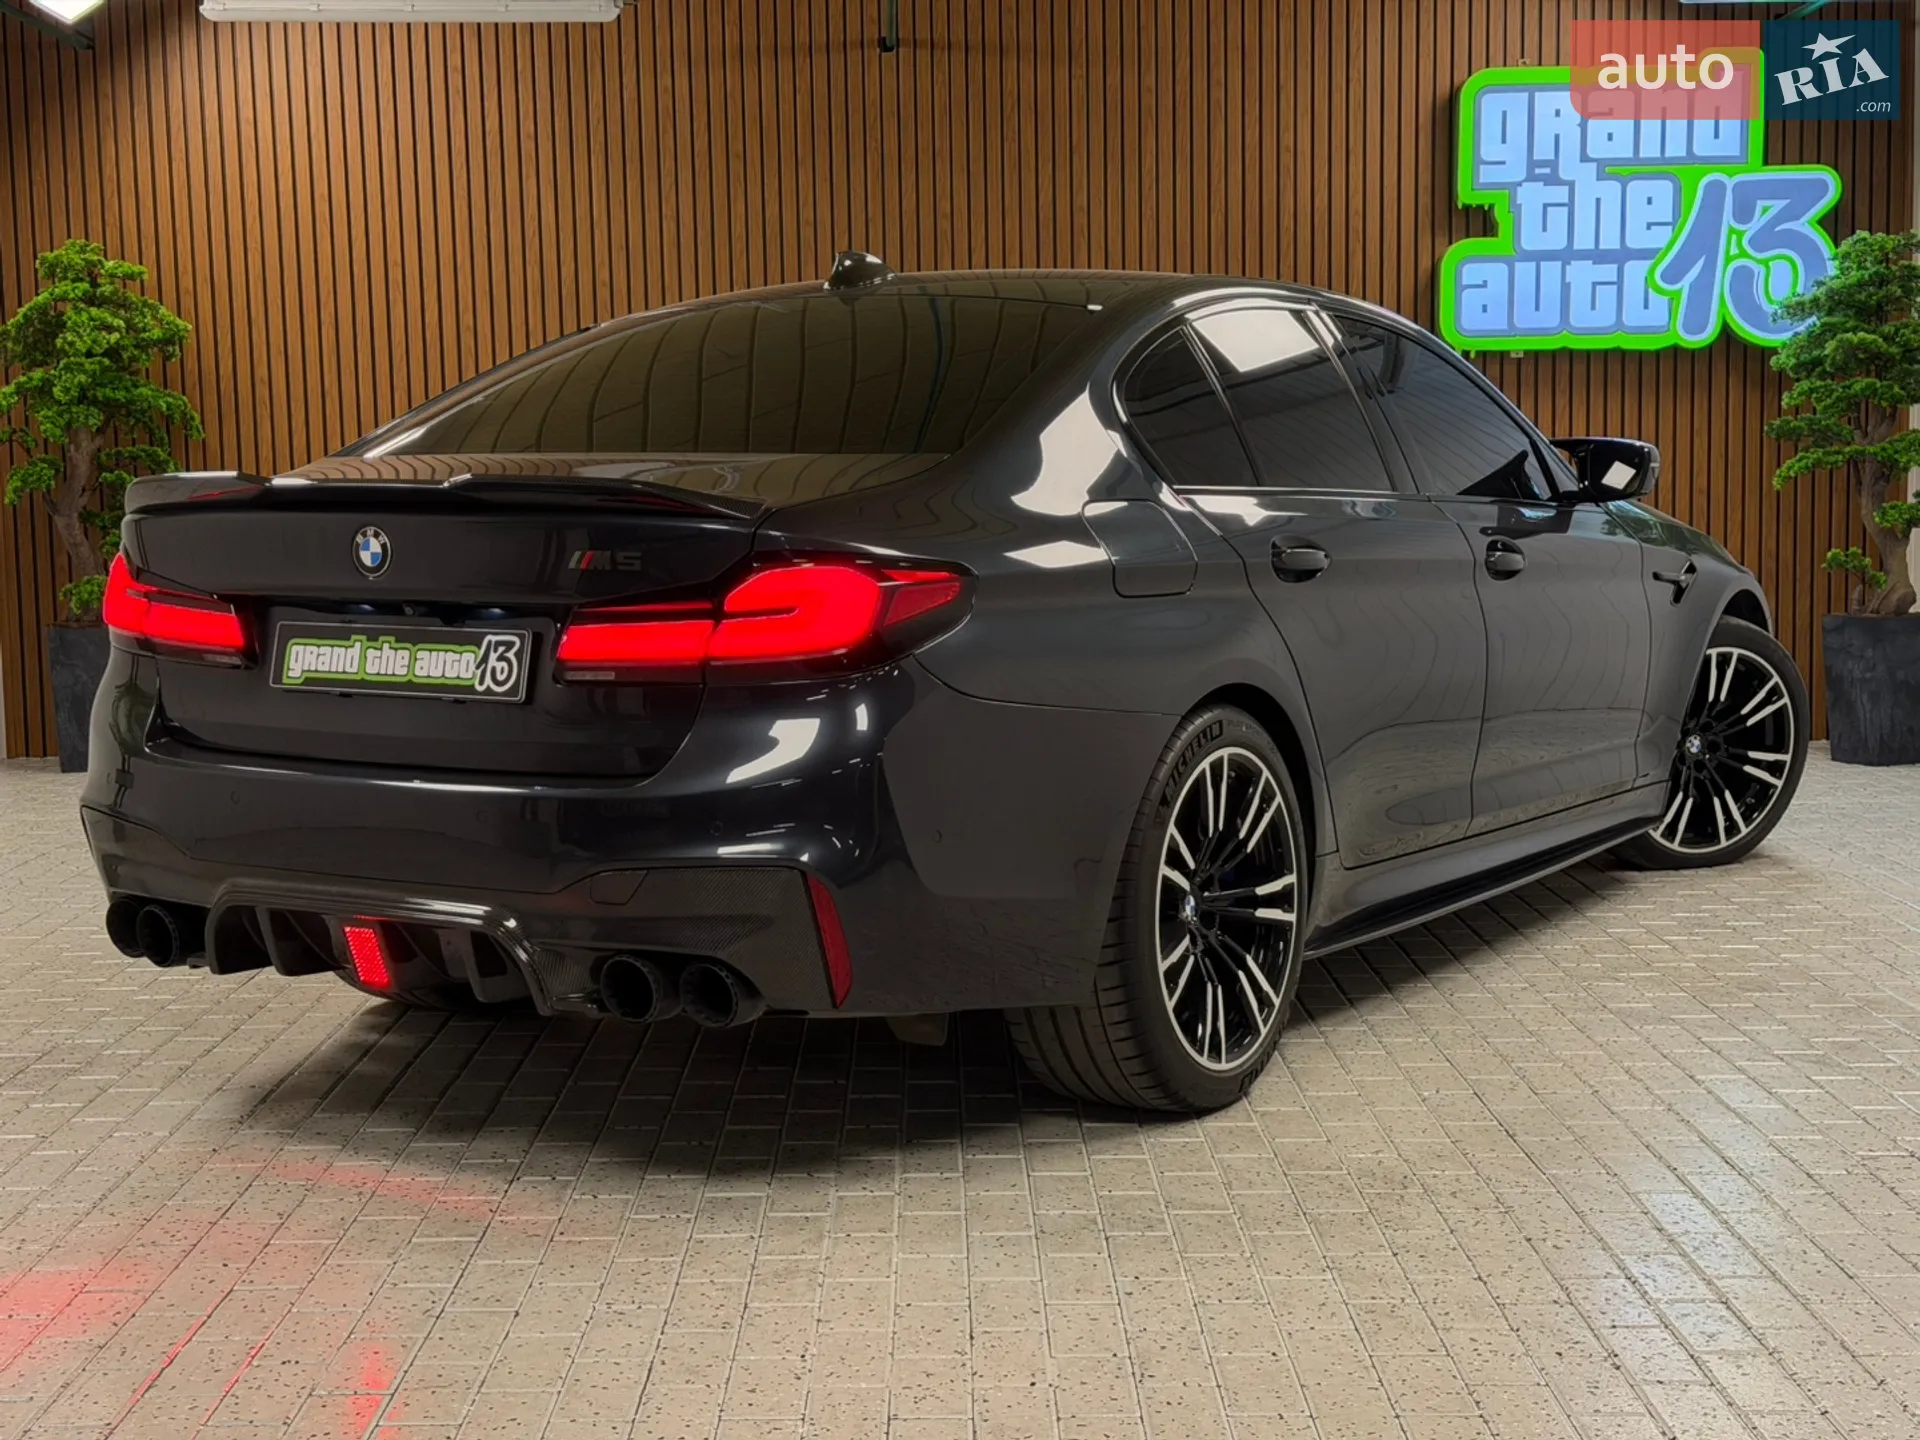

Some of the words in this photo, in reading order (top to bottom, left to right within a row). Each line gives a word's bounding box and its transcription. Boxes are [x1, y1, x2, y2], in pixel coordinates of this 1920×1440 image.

[1516, 165, 1674, 251] the
[1461, 260, 1671, 331] auto
[1656, 172, 1834, 341] 13
[365, 642, 412, 676] the
[414, 649, 476, 680] auto
[474, 634, 521, 692] 13
